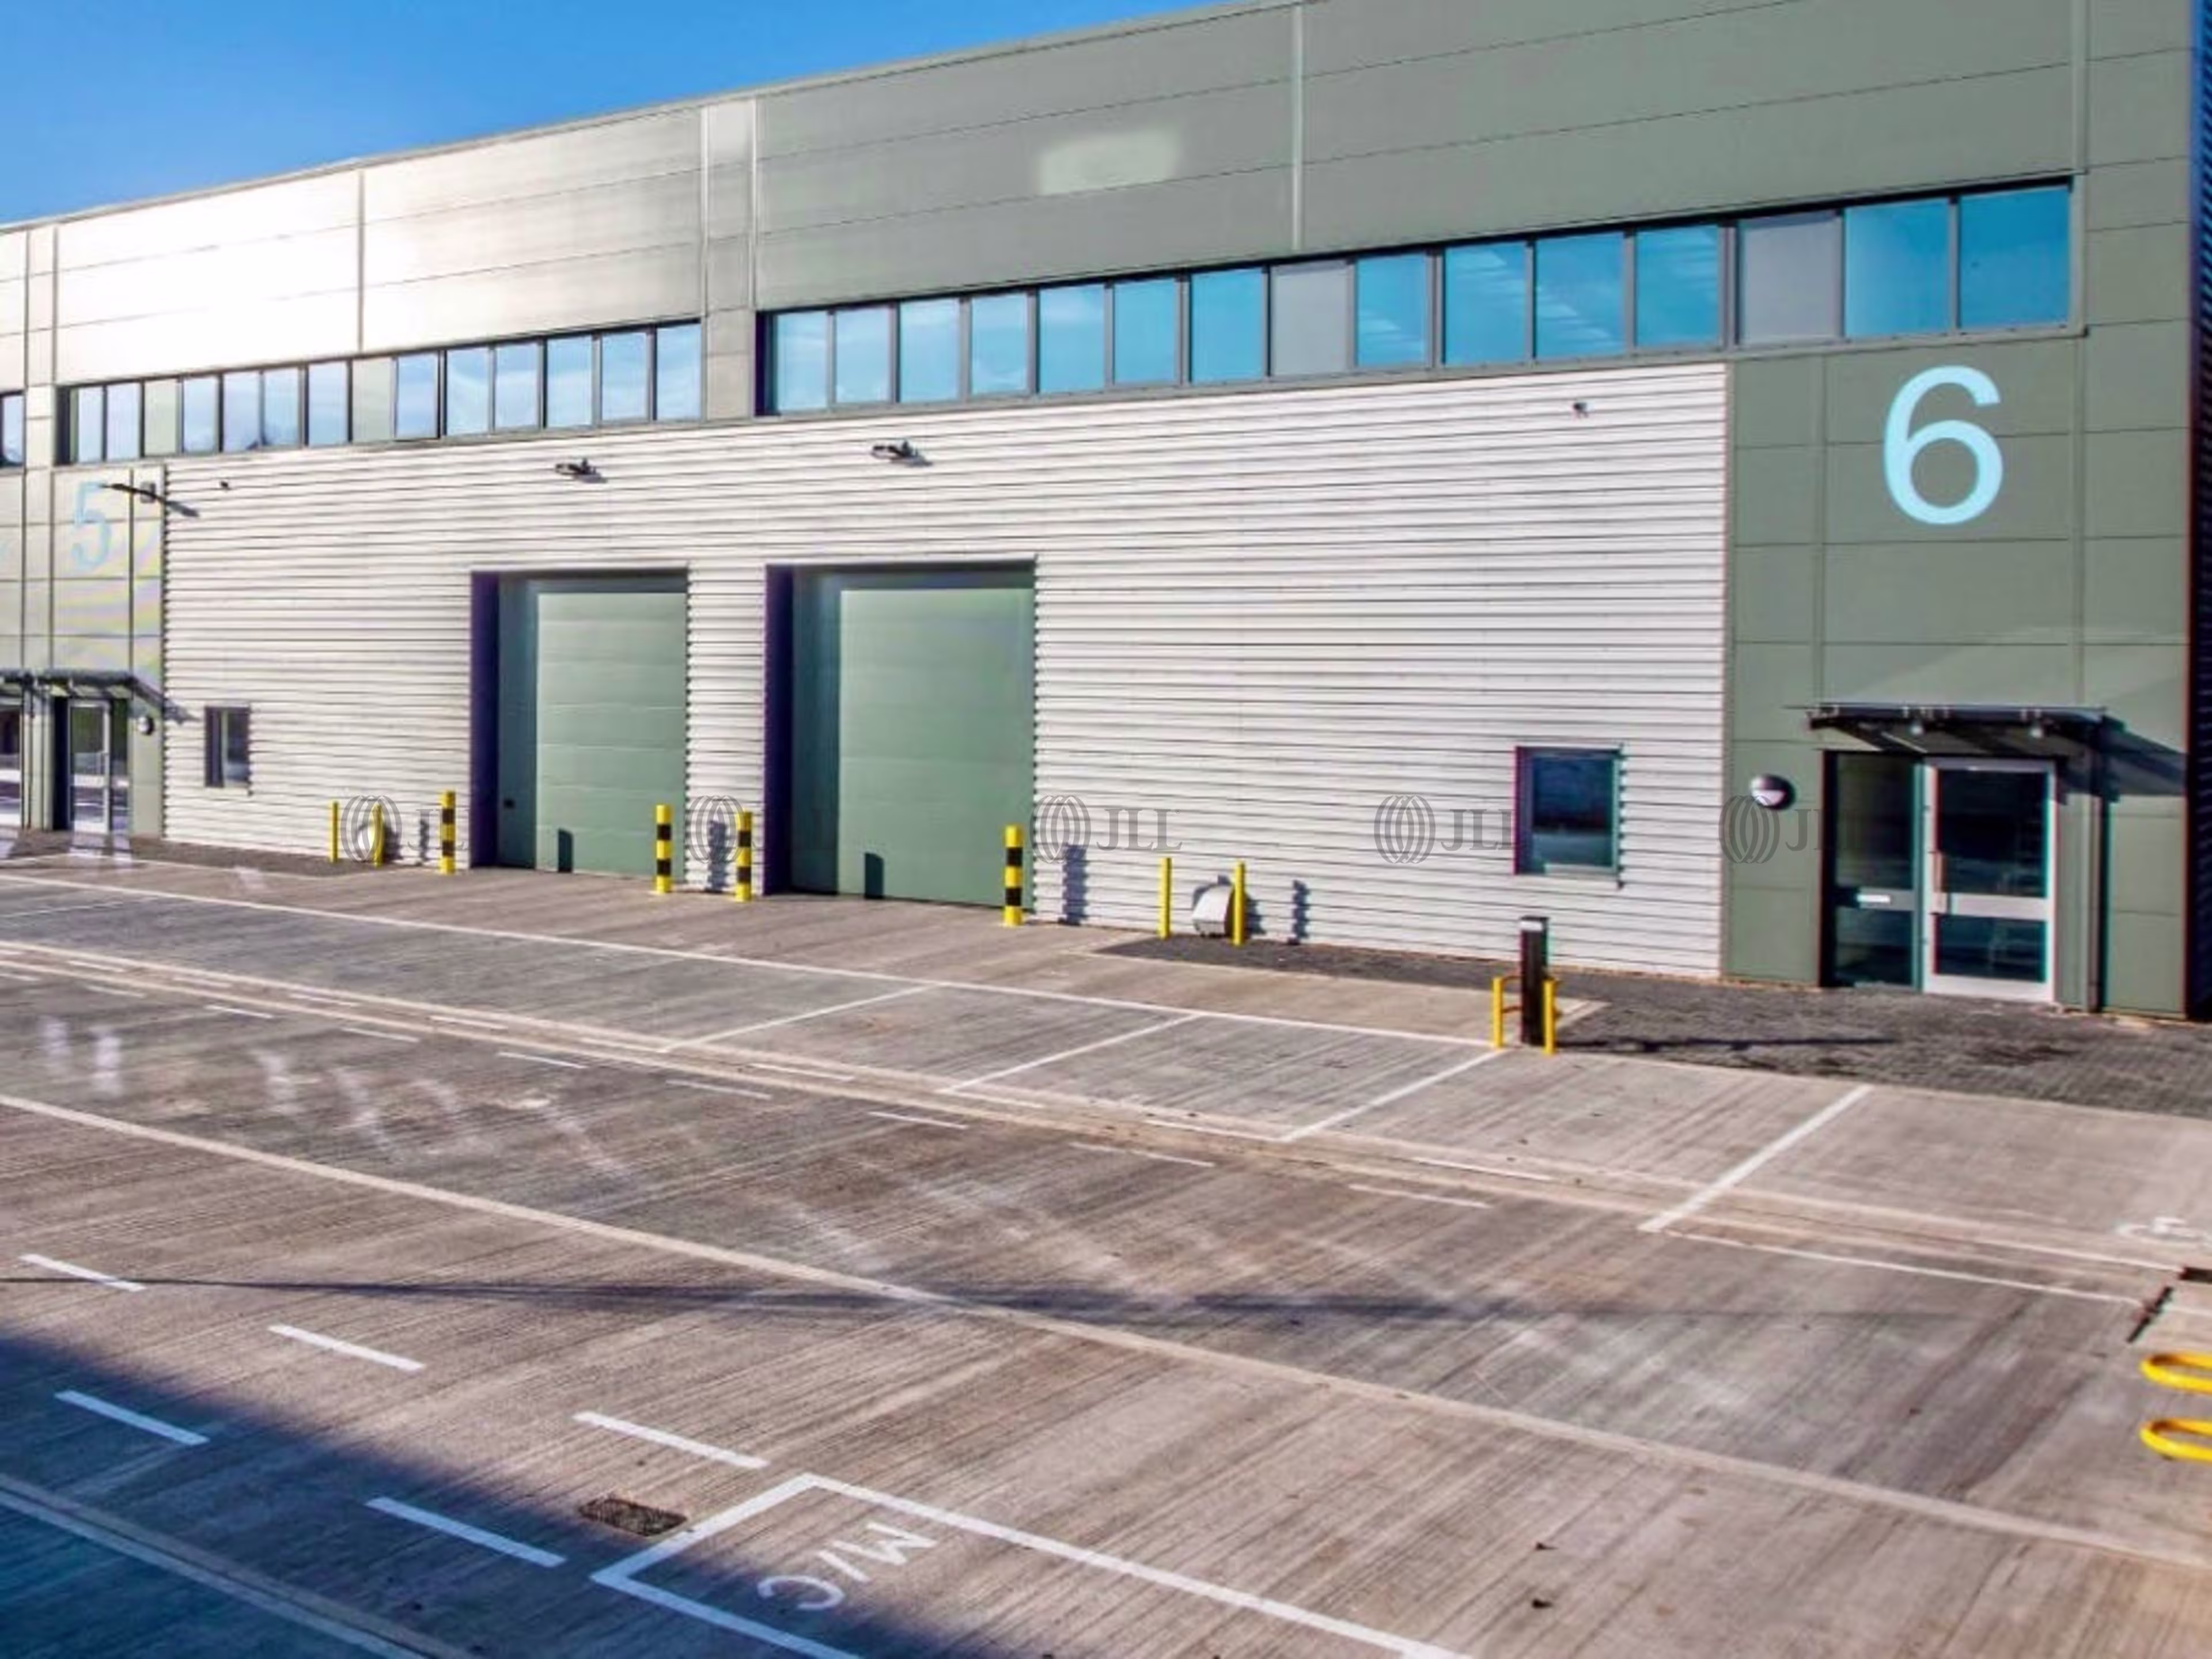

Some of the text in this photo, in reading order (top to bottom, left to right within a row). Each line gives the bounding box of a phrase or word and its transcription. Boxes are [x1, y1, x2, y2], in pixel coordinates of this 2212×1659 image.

[1884, 365, 2003, 525] 6
[71, 482, 111, 570] 5
[757, 1522, 938, 1610] M/C
